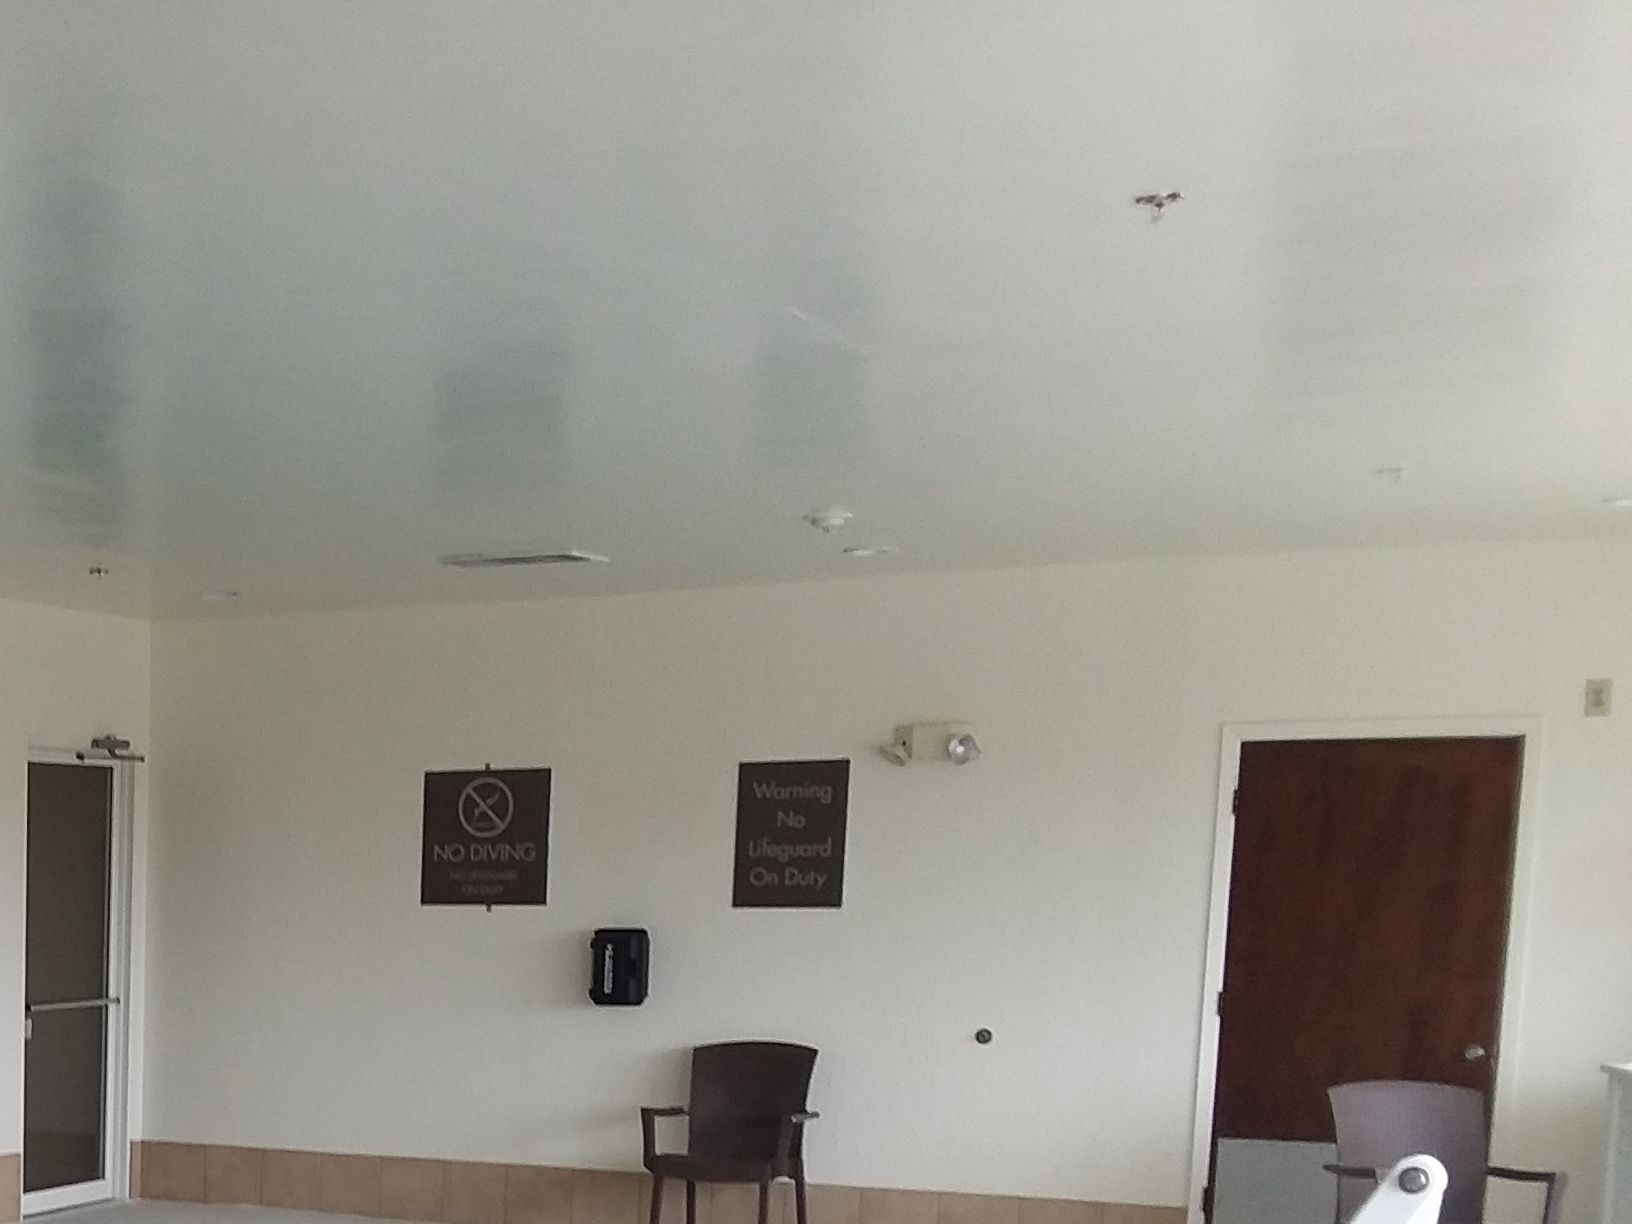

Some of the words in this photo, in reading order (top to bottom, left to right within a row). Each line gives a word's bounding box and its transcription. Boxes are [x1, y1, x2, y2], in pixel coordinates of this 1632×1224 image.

[752, 781, 834, 803] Warning
[777, 811, 806, 828] No
[433, 844, 465, 862] NO
[470, 842, 536, 861] DIVING
[749, 836, 833, 863] Lifeguard
[749, 866, 779, 887] On
[784, 867, 828, 890] Duty
